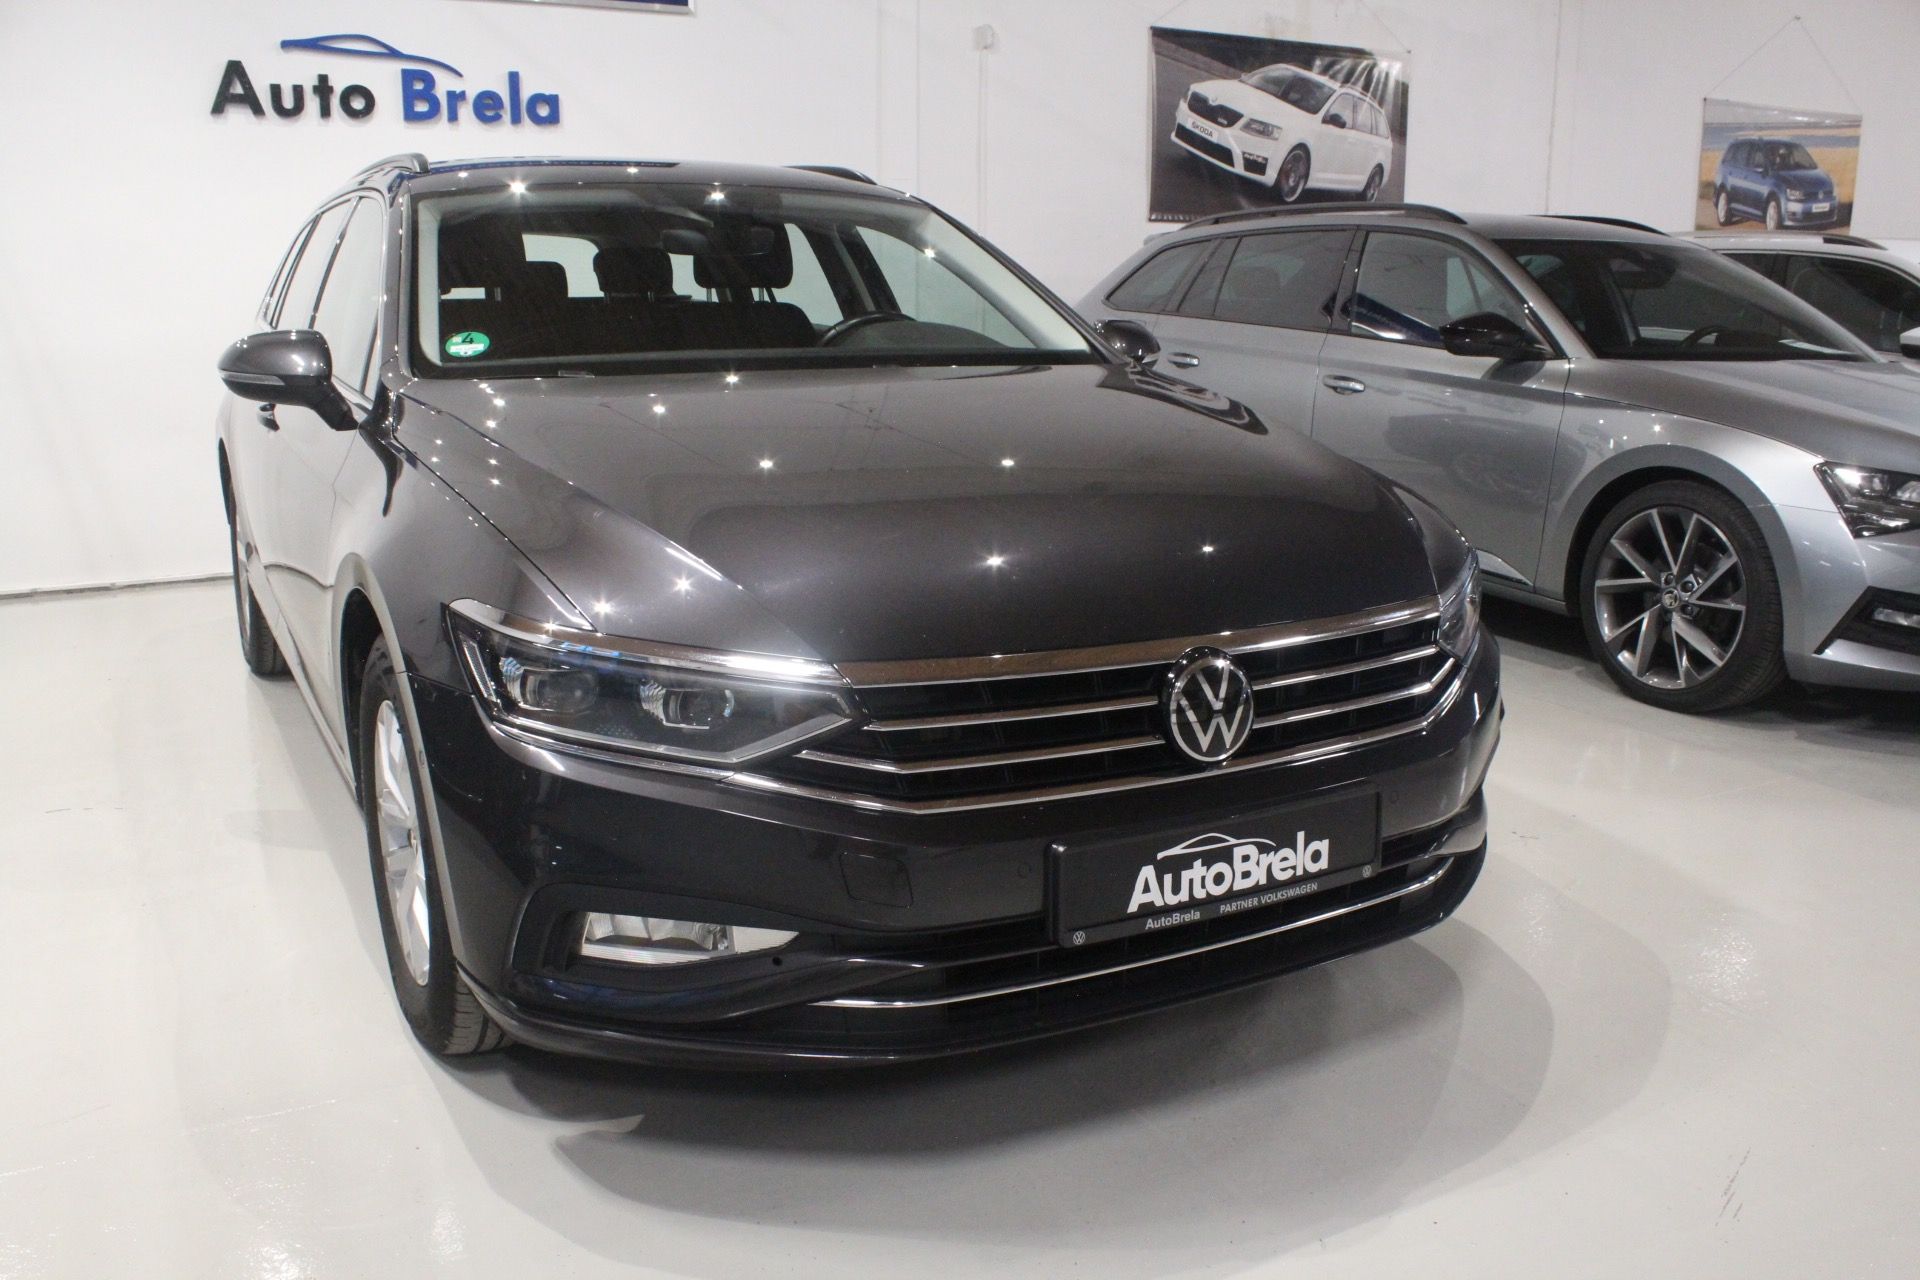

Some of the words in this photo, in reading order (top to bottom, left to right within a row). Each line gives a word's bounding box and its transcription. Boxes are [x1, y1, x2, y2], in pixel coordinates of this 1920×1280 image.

[210, 59, 376, 119] Auto
[400, 68, 560, 126] Brela
[461, 333, 474, 344] 4
[1127, 830, 1330, 913] AutoBrela
[1220, 898, 1258, 913] PARTNER
[1260, 883, 1318, 904] VOLKSWAGEN
[1145, 910, 1201, 930] AutoBrela
